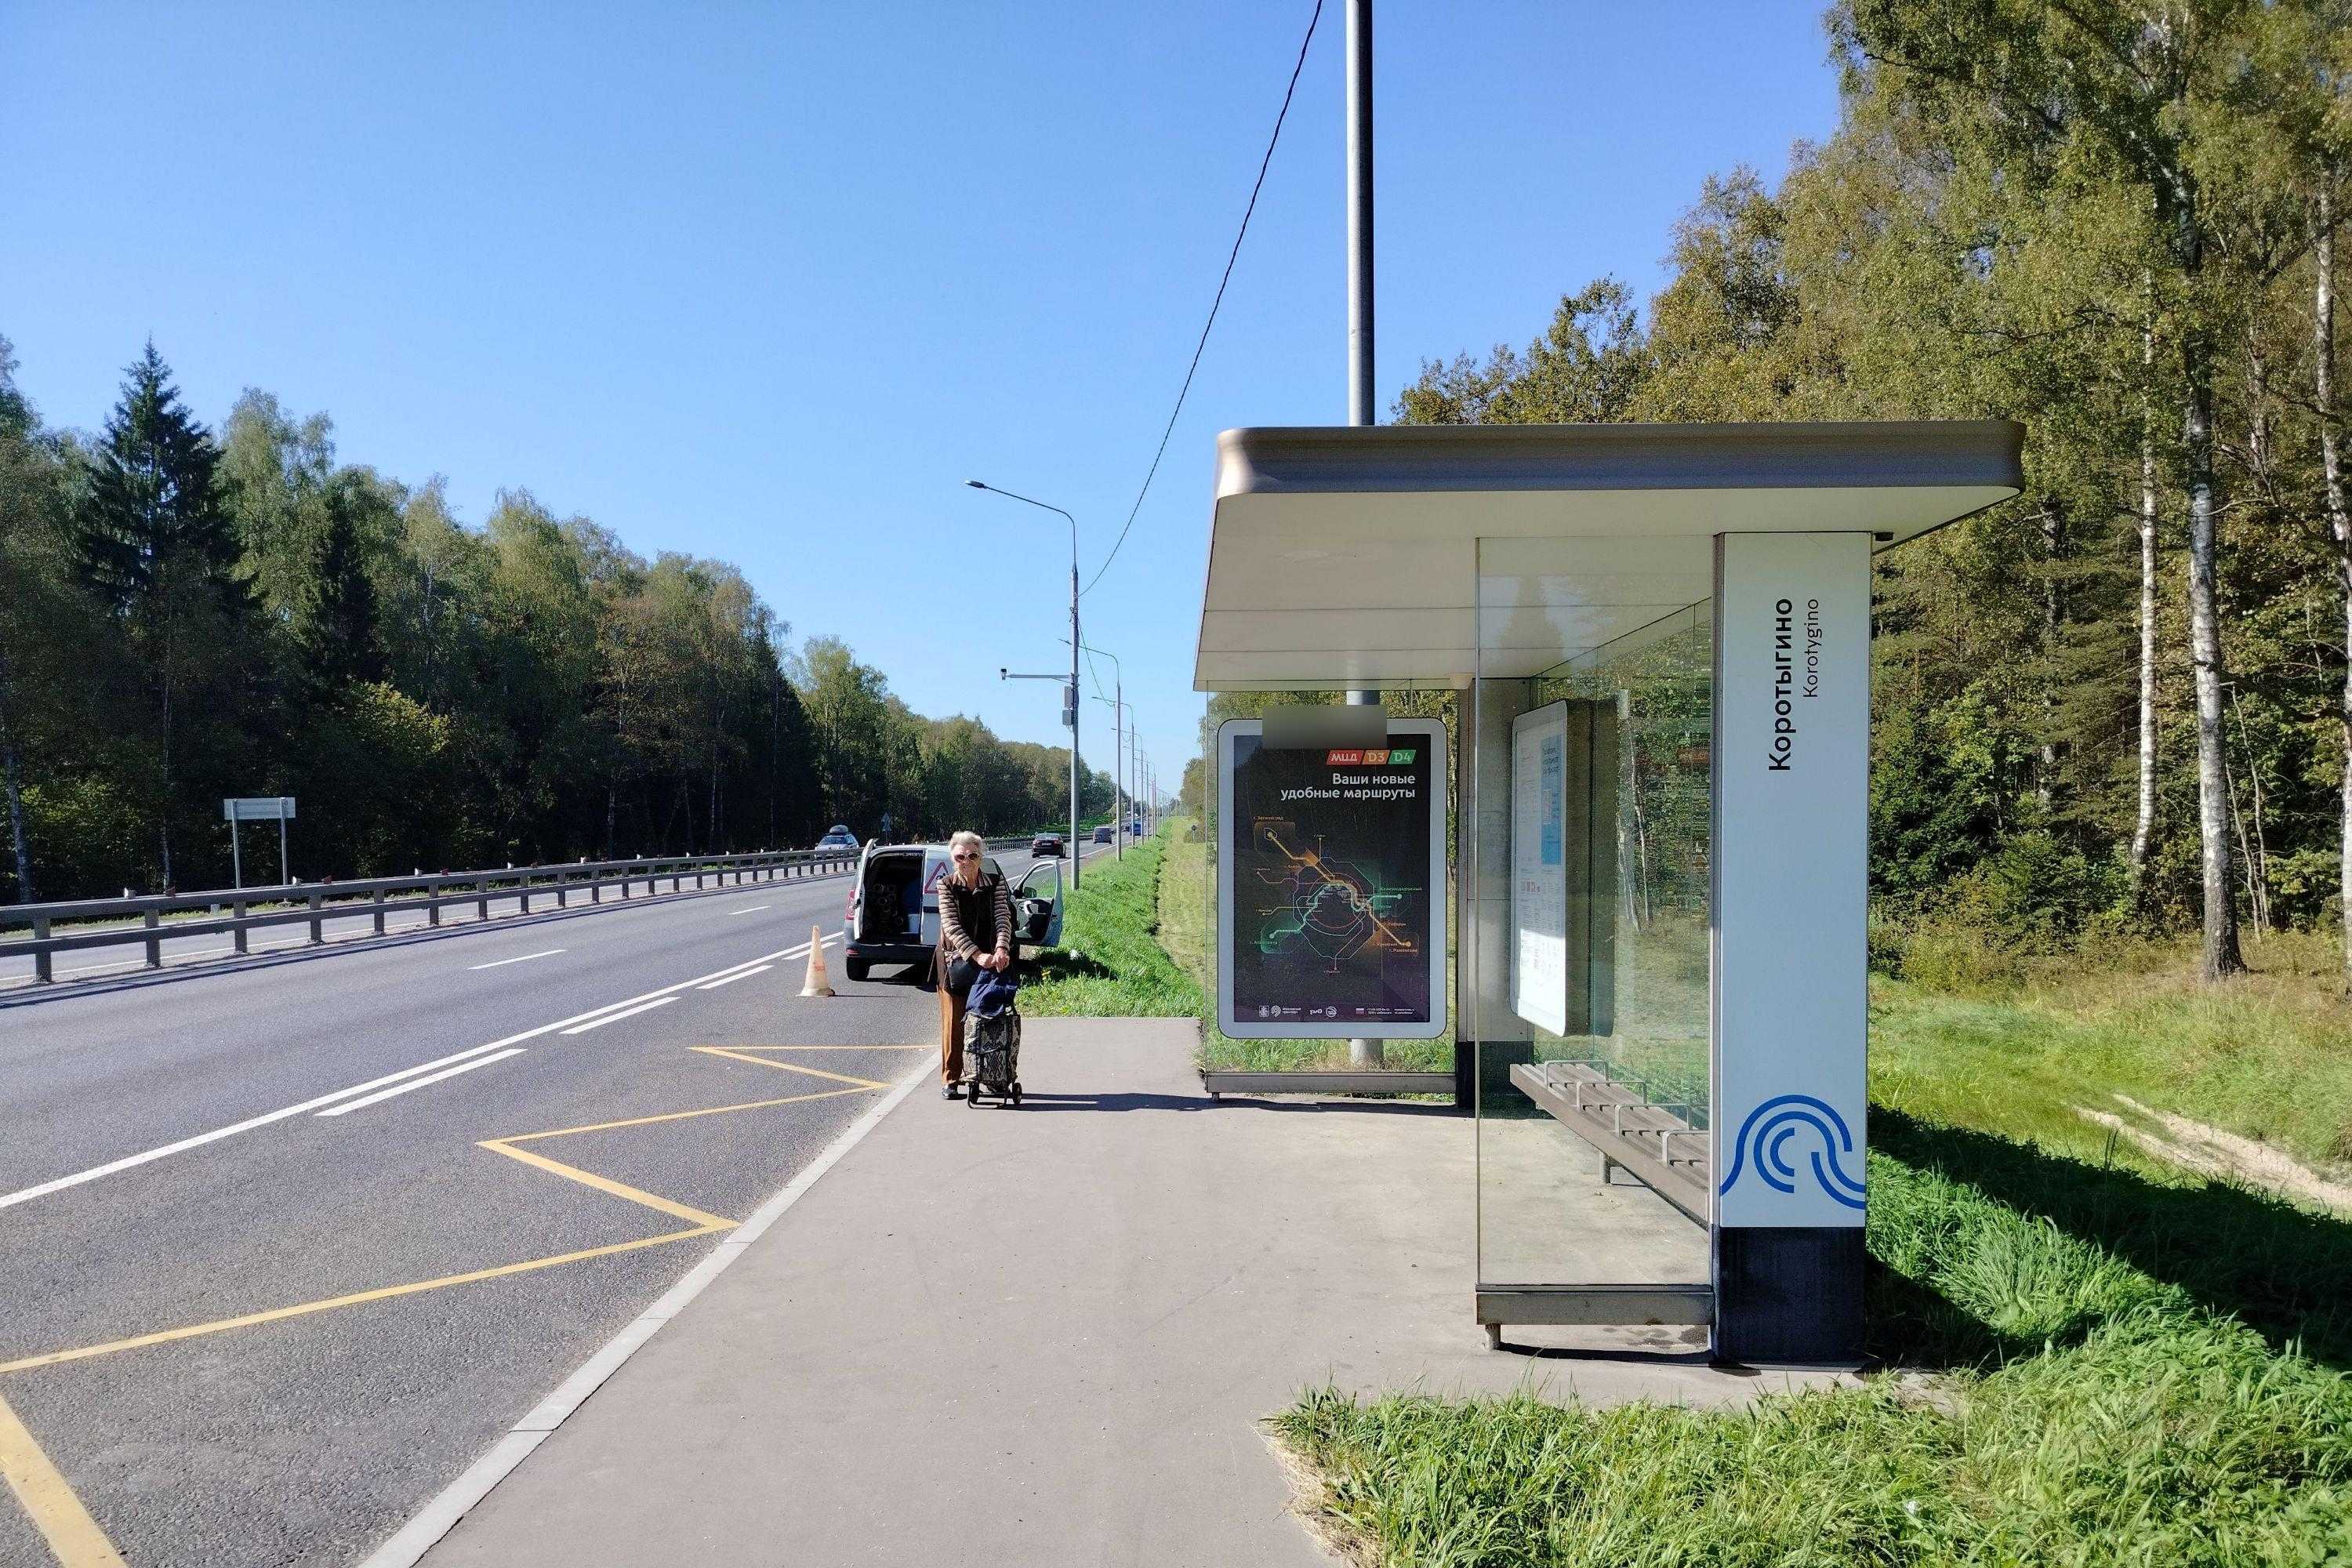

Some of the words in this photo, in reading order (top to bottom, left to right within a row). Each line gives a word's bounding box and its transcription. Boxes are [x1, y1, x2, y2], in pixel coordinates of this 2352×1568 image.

[1803, 599, 1822, 697] Korotygino
[1769, 598, 1796, 770] Коротыгино
[1330, 751, 1358, 761] МЦД
[1367, 751, 1385, 762] D3
[1393, 751, 1412, 762] D4
[1333, 773, 1369, 784] Ваши
[1372, 775, 1416, 784] новые
[1280, 787, 1340, 800] удобные
[1343, 789, 1415, 800] маршруты
